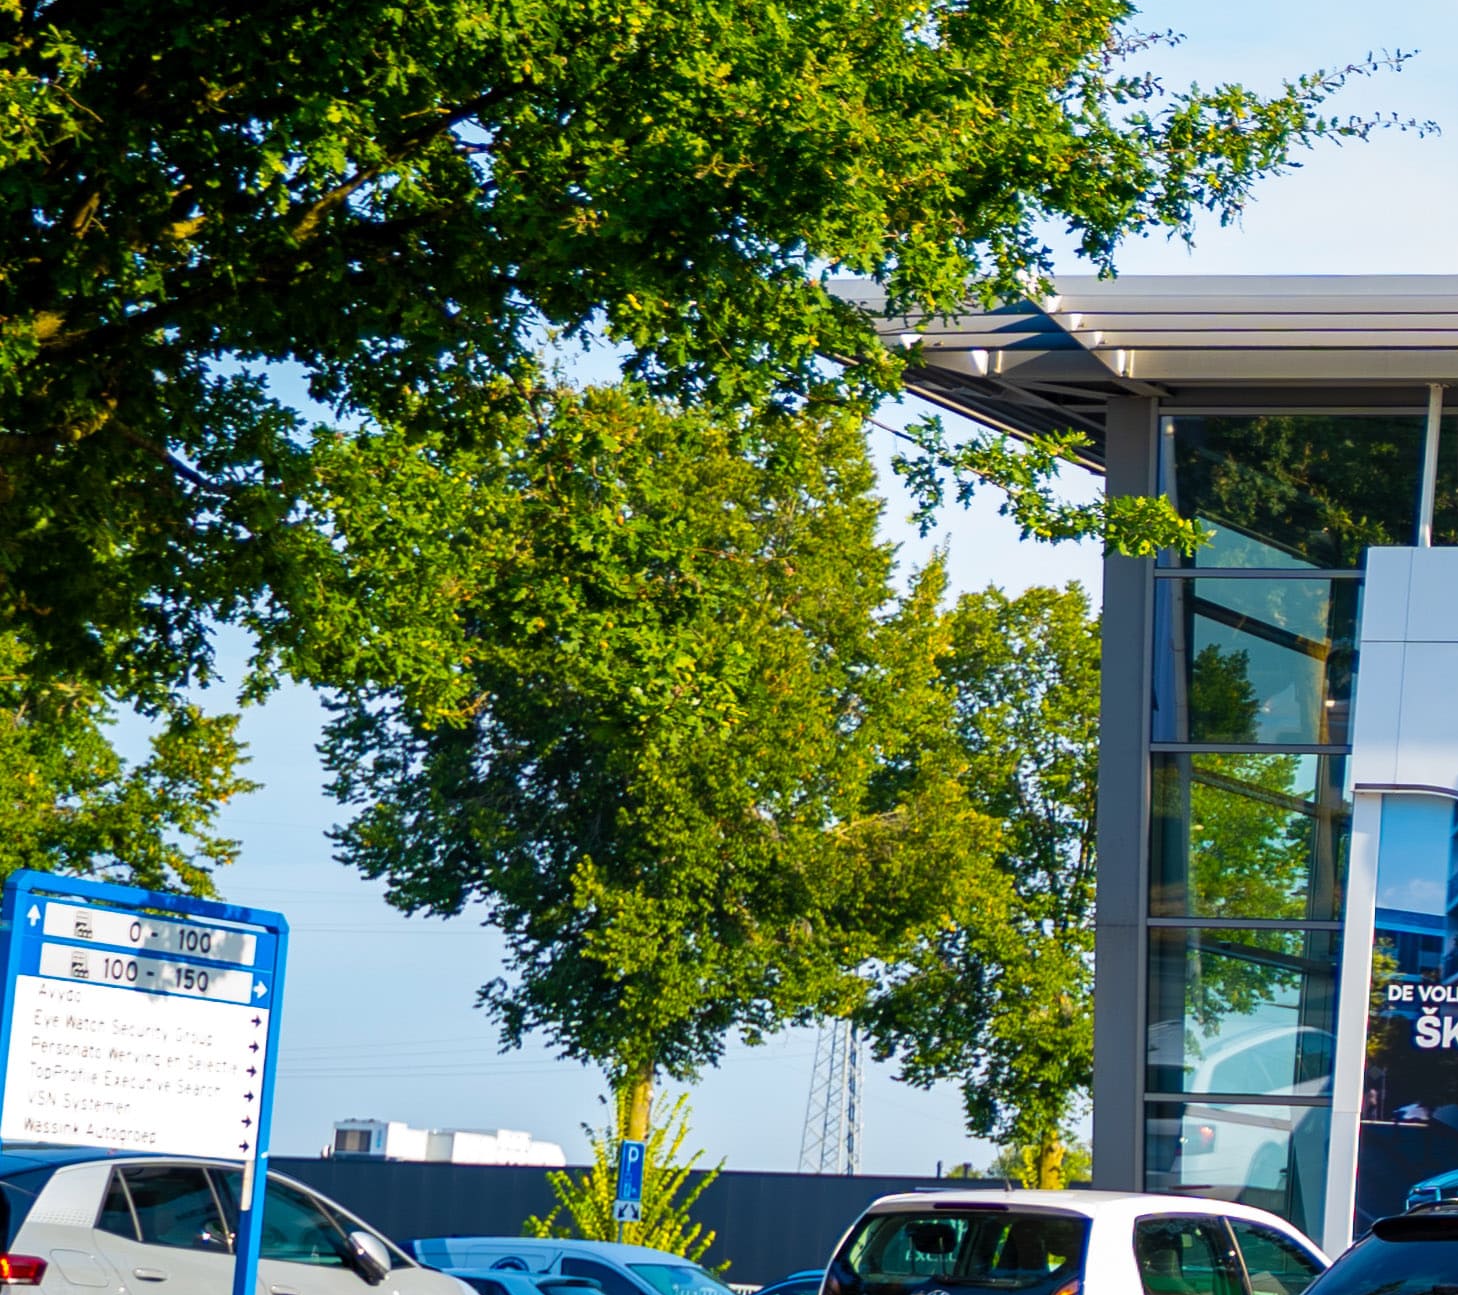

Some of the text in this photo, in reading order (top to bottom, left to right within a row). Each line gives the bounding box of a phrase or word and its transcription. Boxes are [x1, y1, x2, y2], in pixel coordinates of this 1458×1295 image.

[129, 921, 142, 943] 0
[179, 928, 212, 954] 100
[104, 957, 138, 982] 100
[175, 967, 209, 993] 150
[1388, 985, 1414, 1002] DE
